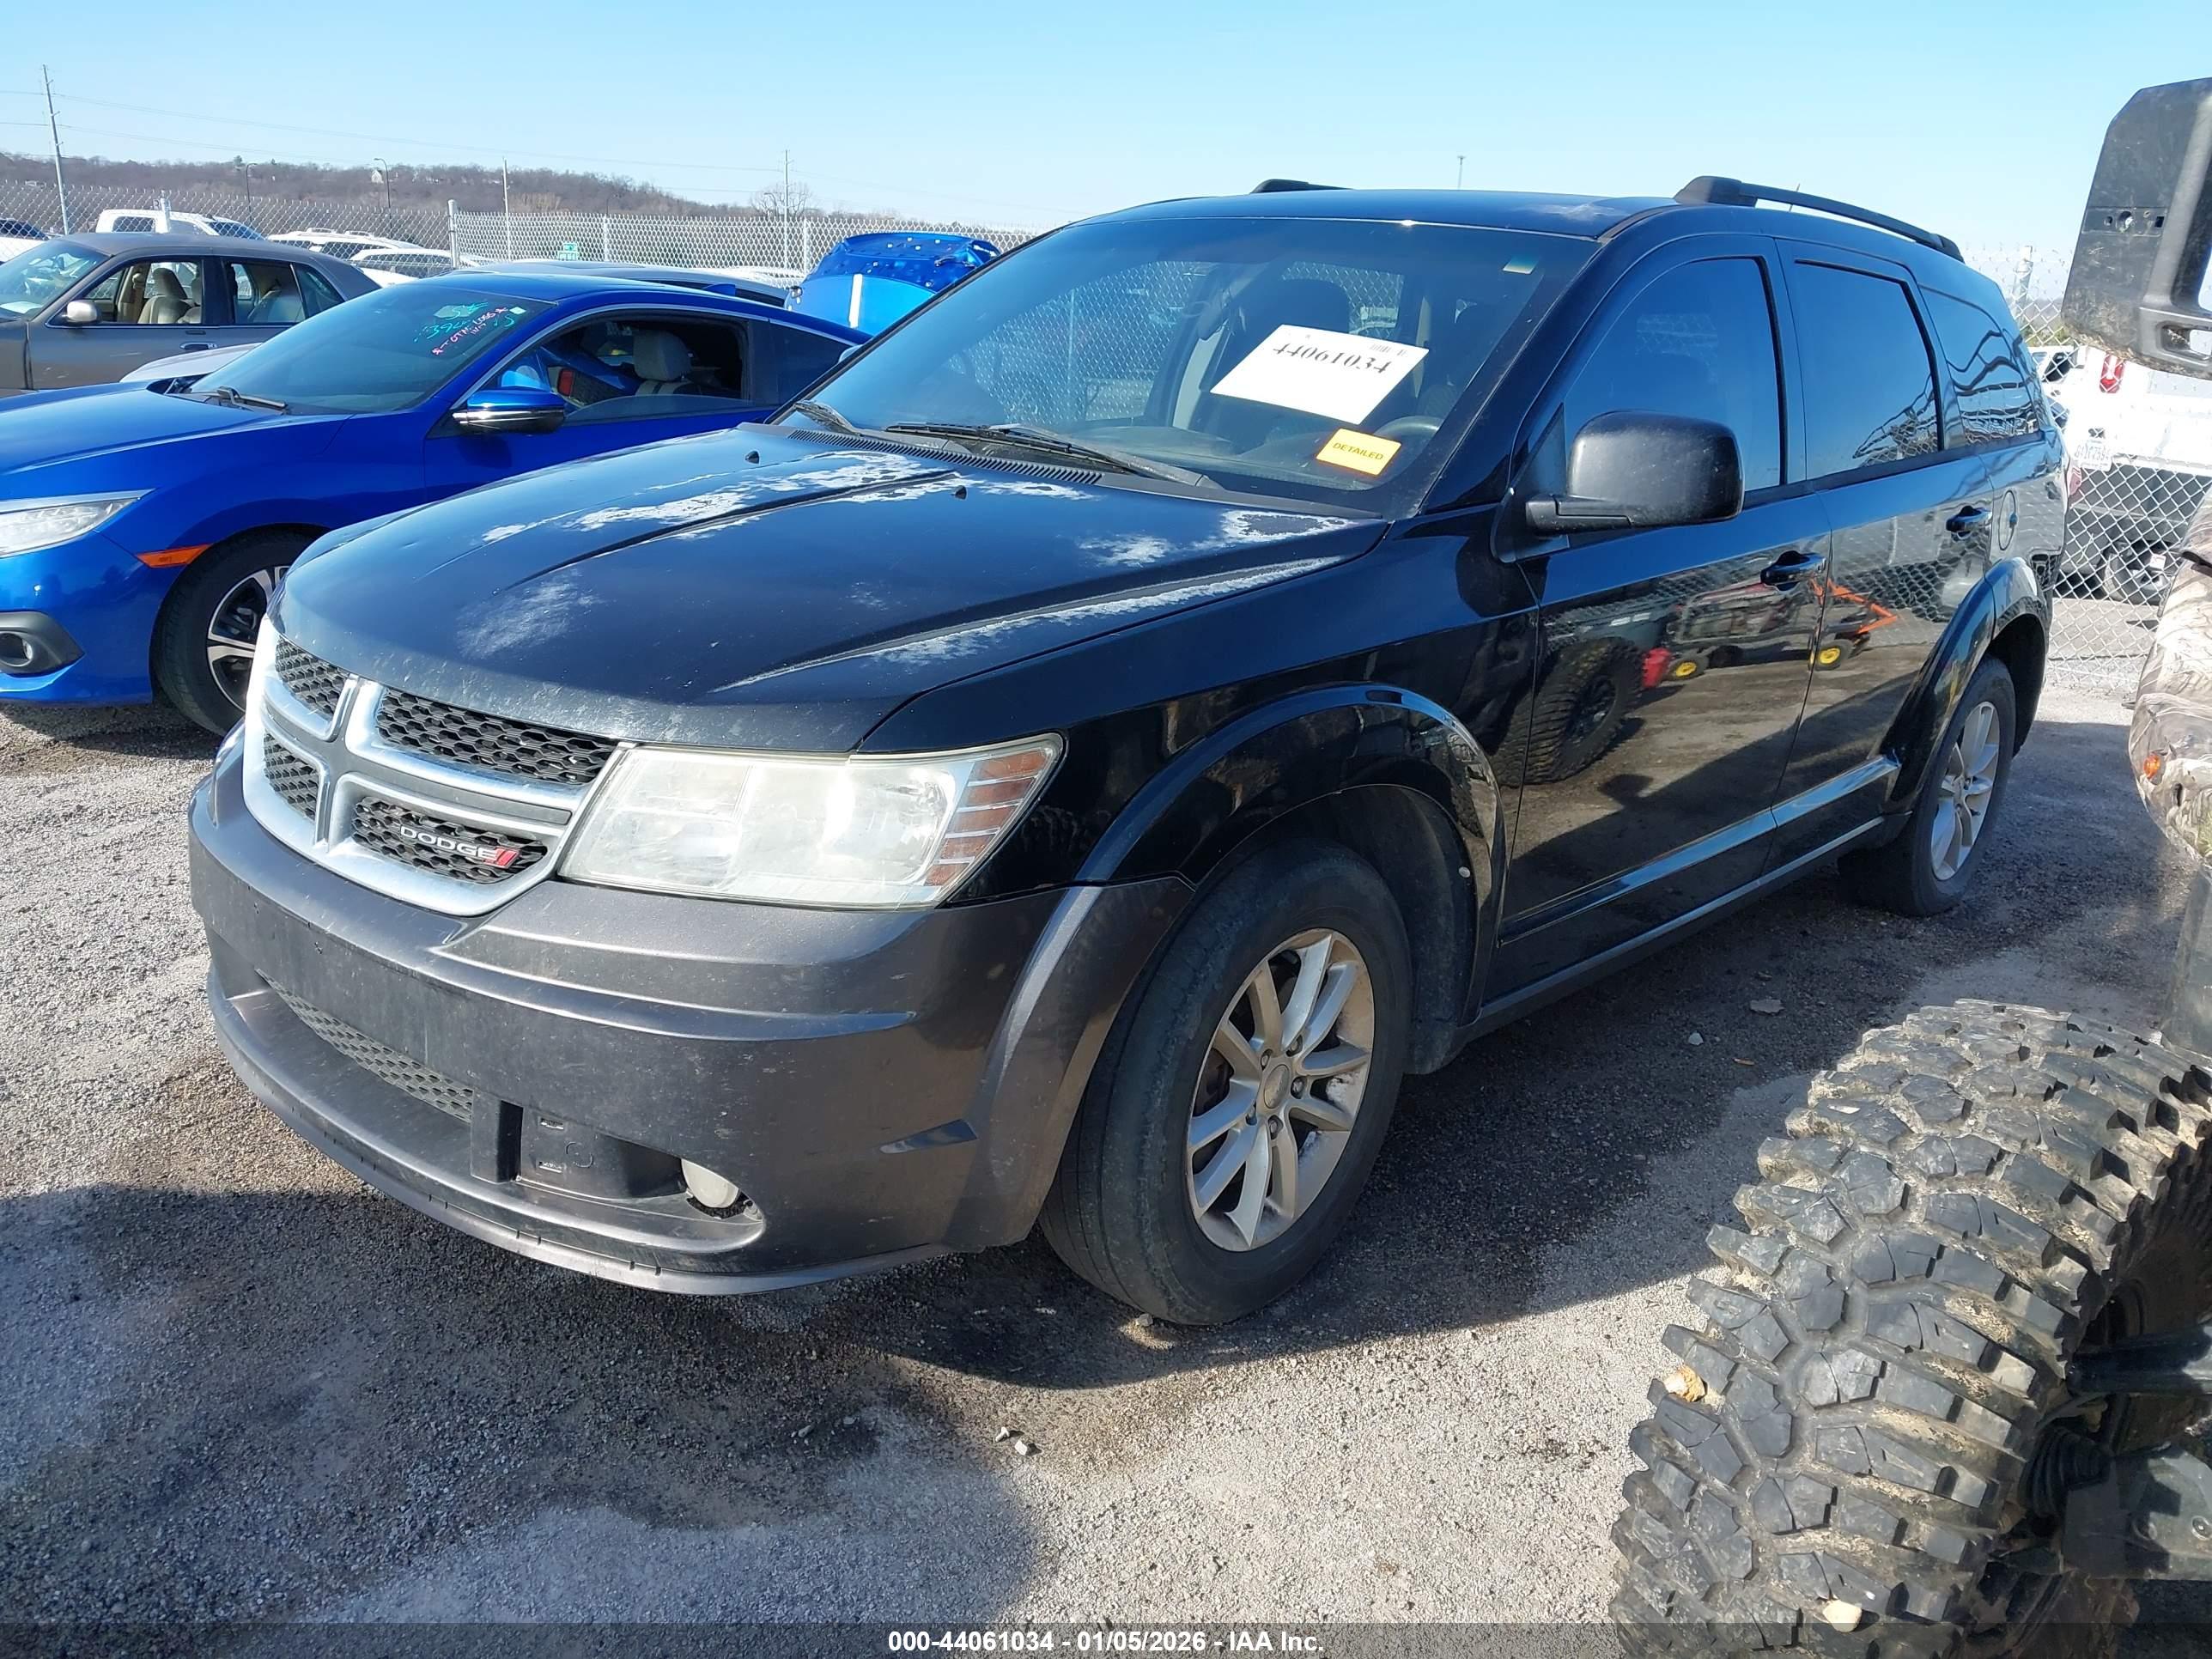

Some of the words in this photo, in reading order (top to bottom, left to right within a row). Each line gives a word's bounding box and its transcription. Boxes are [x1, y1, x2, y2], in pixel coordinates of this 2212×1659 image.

[1273, 343, 1392, 374] 44061034
[1333, 441, 1383, 461] DETAILED
[400, 825, 498, 860] DODGE
